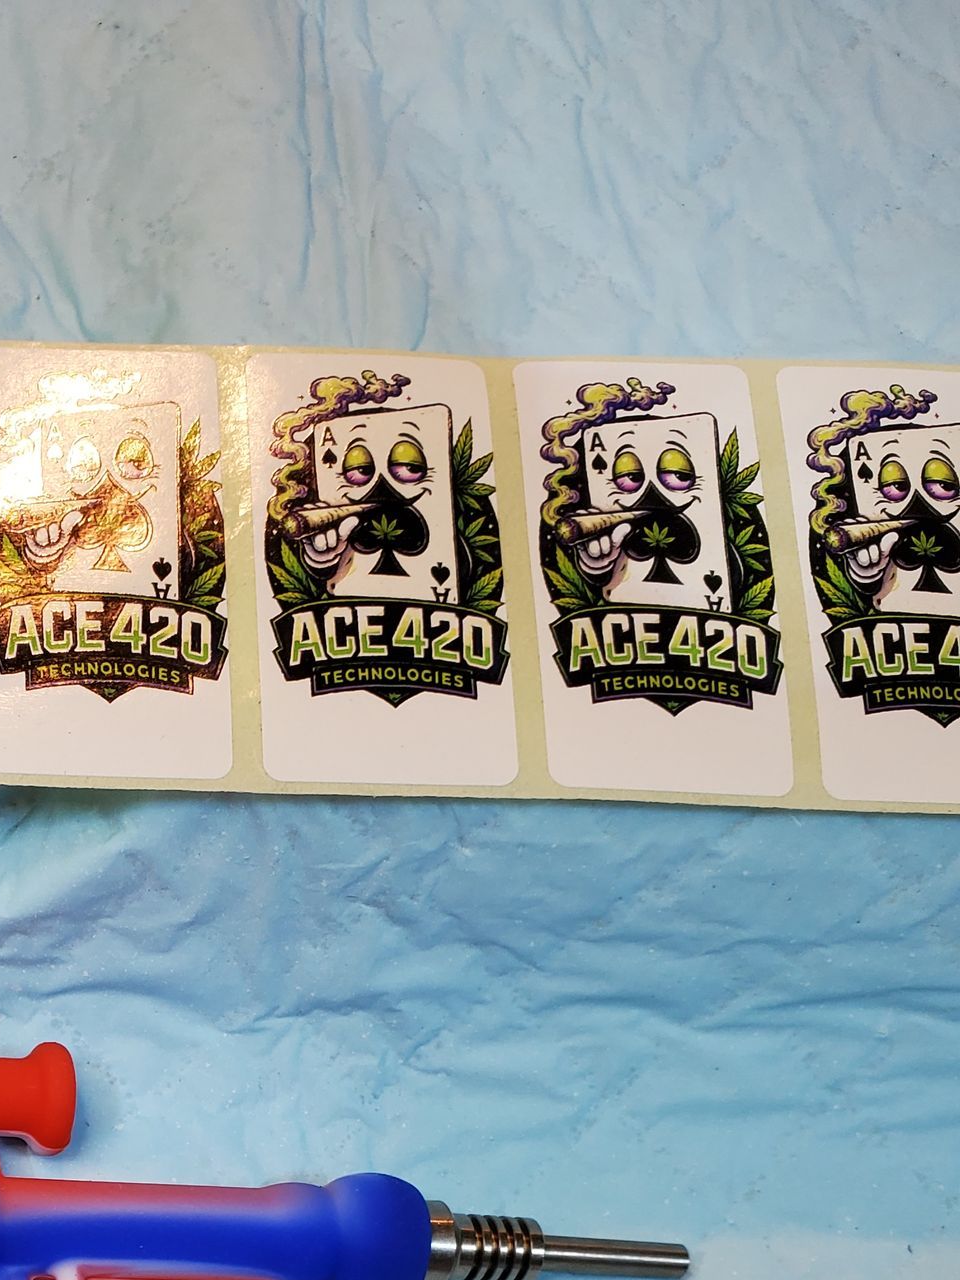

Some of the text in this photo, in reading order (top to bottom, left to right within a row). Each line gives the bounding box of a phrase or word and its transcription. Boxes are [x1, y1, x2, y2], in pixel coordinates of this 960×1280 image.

[322, 426, 337, 446] A
[590, 432, 606, 451] A
[854, 441, 869, 461] A
[5, 601, 211, 663] ACE 420
[290, 606, 491, 667] ACE 420
[570, 613, 767, 676] ACE 420
[841, 623, 935, 682] ACE
[37, 664, 181, 683] TECHNOLOGIES
[322, 667, 464, 688] TECHNOLOGIES
[601, 677, 740, 698] TECHNOLOGIES
